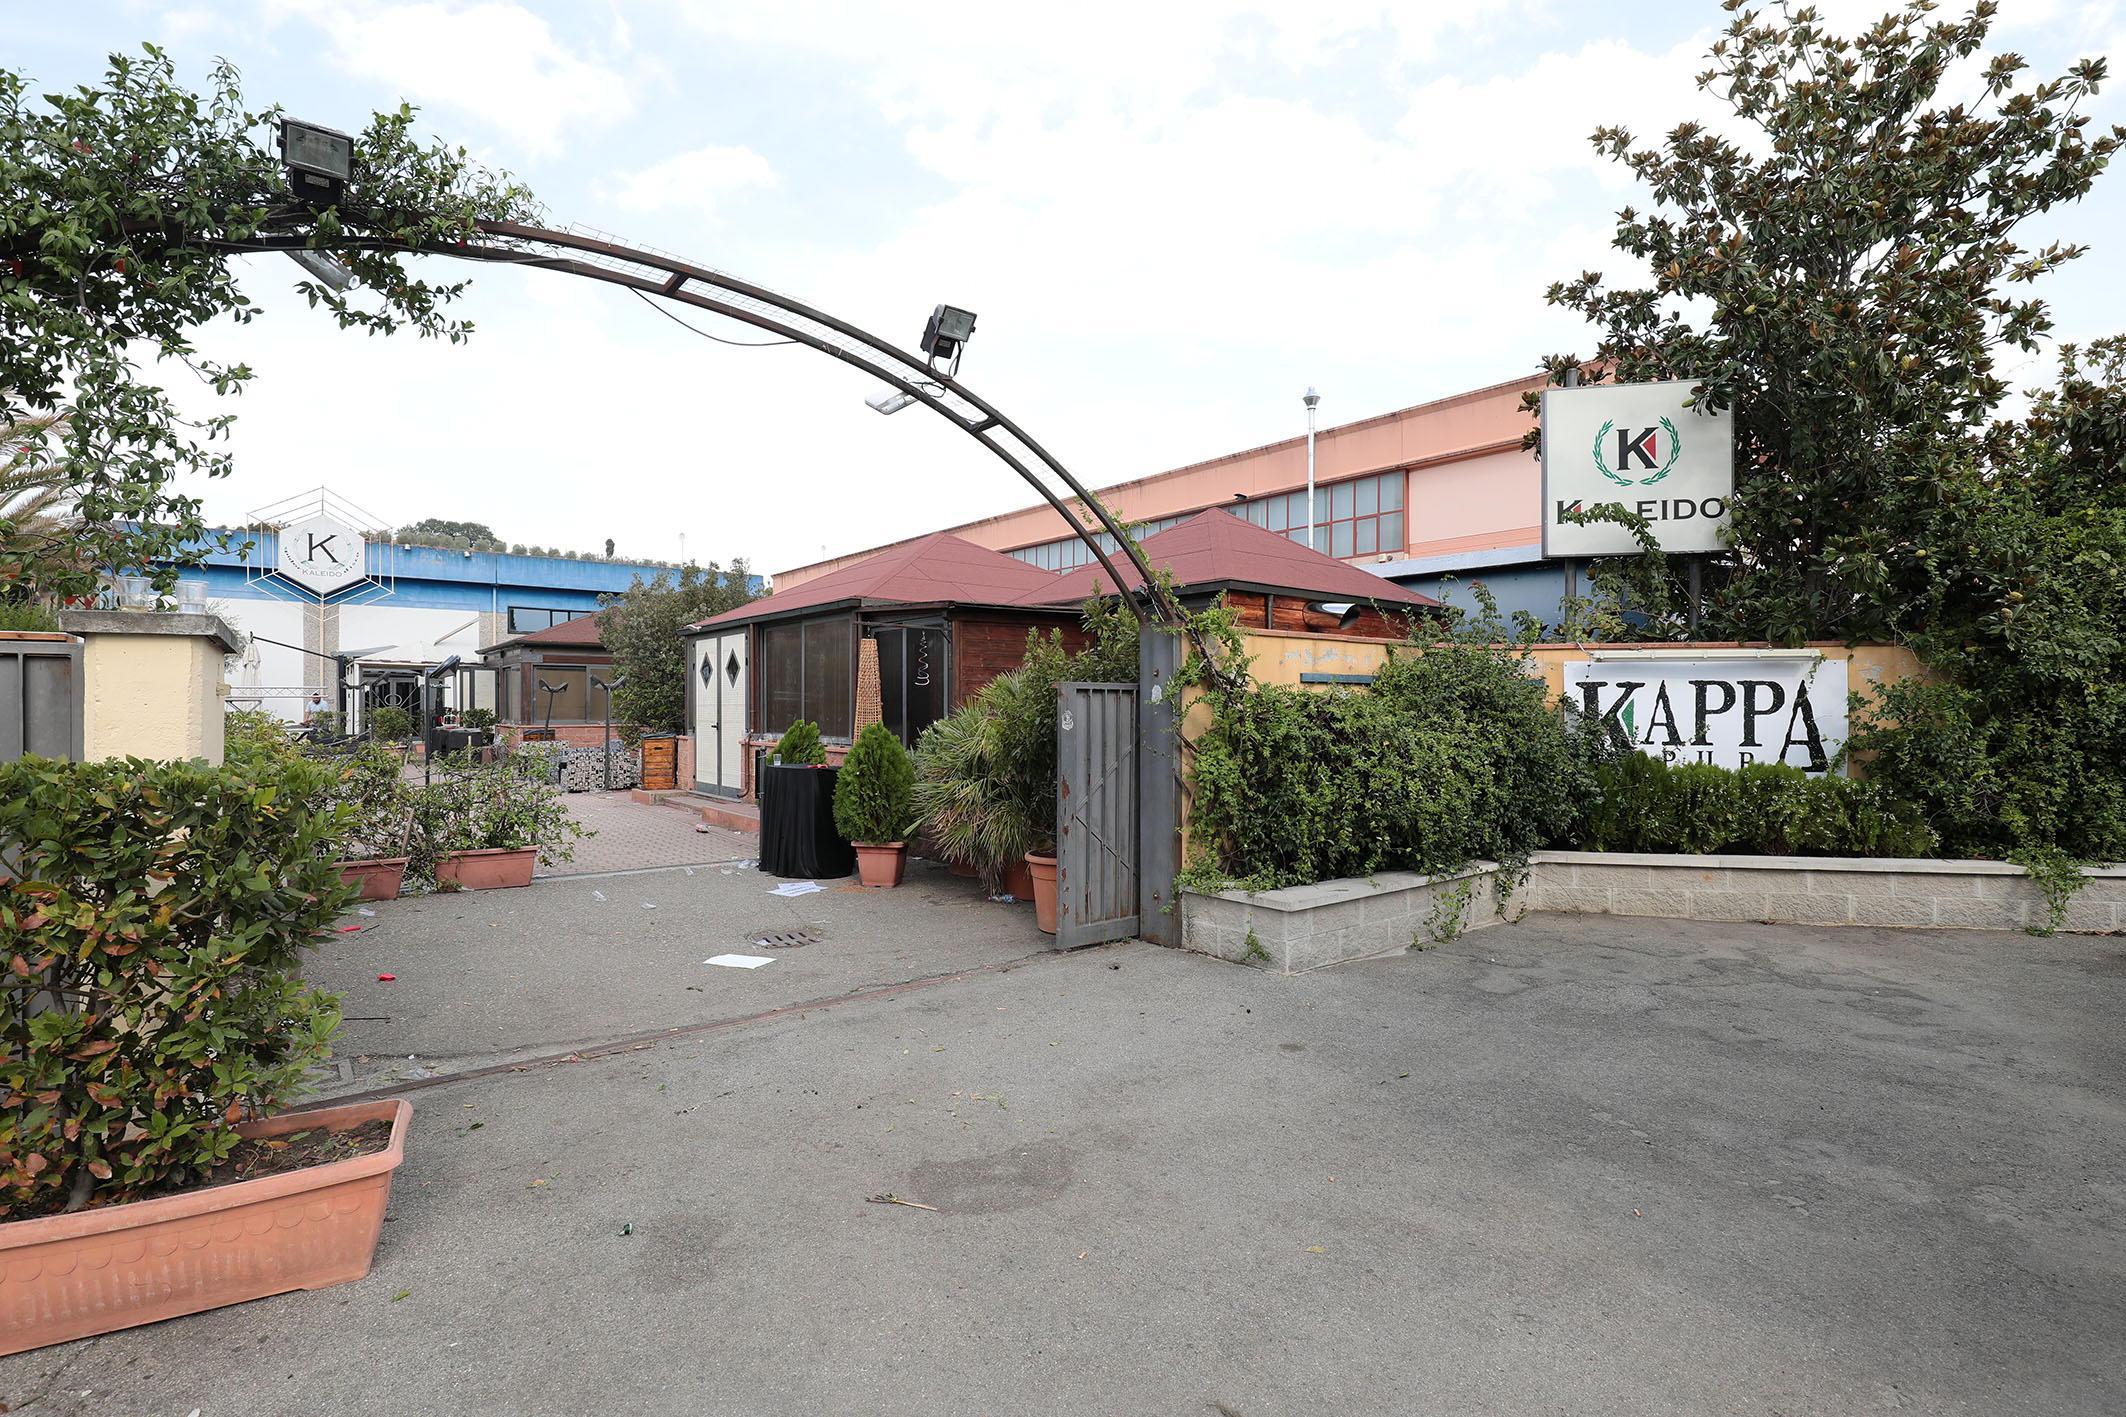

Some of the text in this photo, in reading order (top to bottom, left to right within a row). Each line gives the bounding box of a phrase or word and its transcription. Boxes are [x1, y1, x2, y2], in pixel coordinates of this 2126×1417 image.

[1616, 427, 1660, 471] K
[1556, 497, 1727, 525] KEIDO
[307, 532, 339, 563] K
[302, 569, 342, 578] KALEIDO
[1575, 679, 1828, 773] KAPPA
